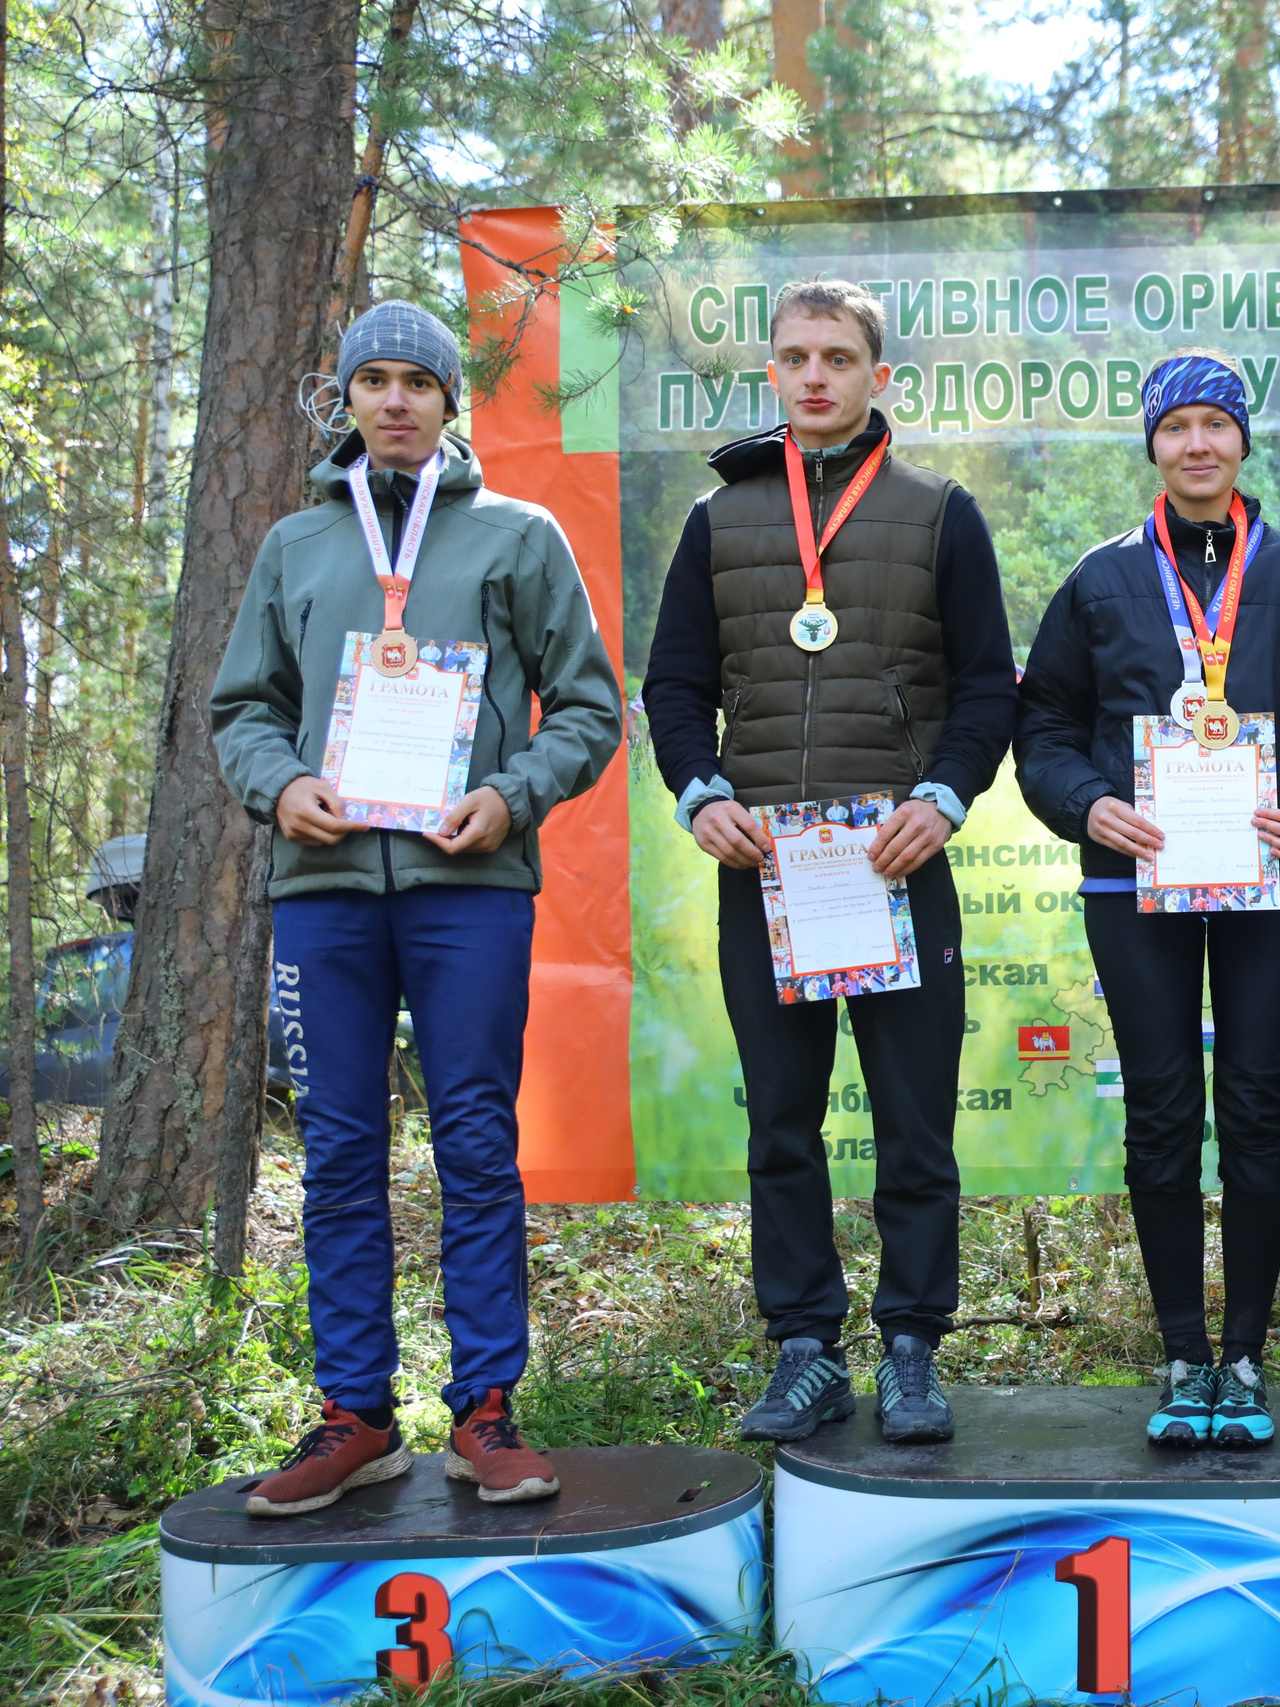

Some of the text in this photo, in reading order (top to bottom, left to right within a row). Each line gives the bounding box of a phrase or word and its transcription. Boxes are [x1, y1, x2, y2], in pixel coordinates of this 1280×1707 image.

[689, 275, 1109, 346] СПТИВНОЕ
[659, 370, 787, 431] ПУТ
[892, 354, 1278, 434] ЗДОРОВУ
[828, 495, 855, 533] ОБЛАСТЬ
[404, 515, 422, 559] ОБЛАСТЬ
[1223, 579, 1238, 623] ОБЛАСТЬ
[369, 680, 449, 698] ГРАМОТА
[1164, 760, 1245, 773] ГРАМОТА
[788, 842, 870, 862] ГРАМОТА
[276, 961, 310, 1098] RUSSIA
[375, 1571, 454, 1697] 3
[1055, 1535, 1131, 1694] 1
